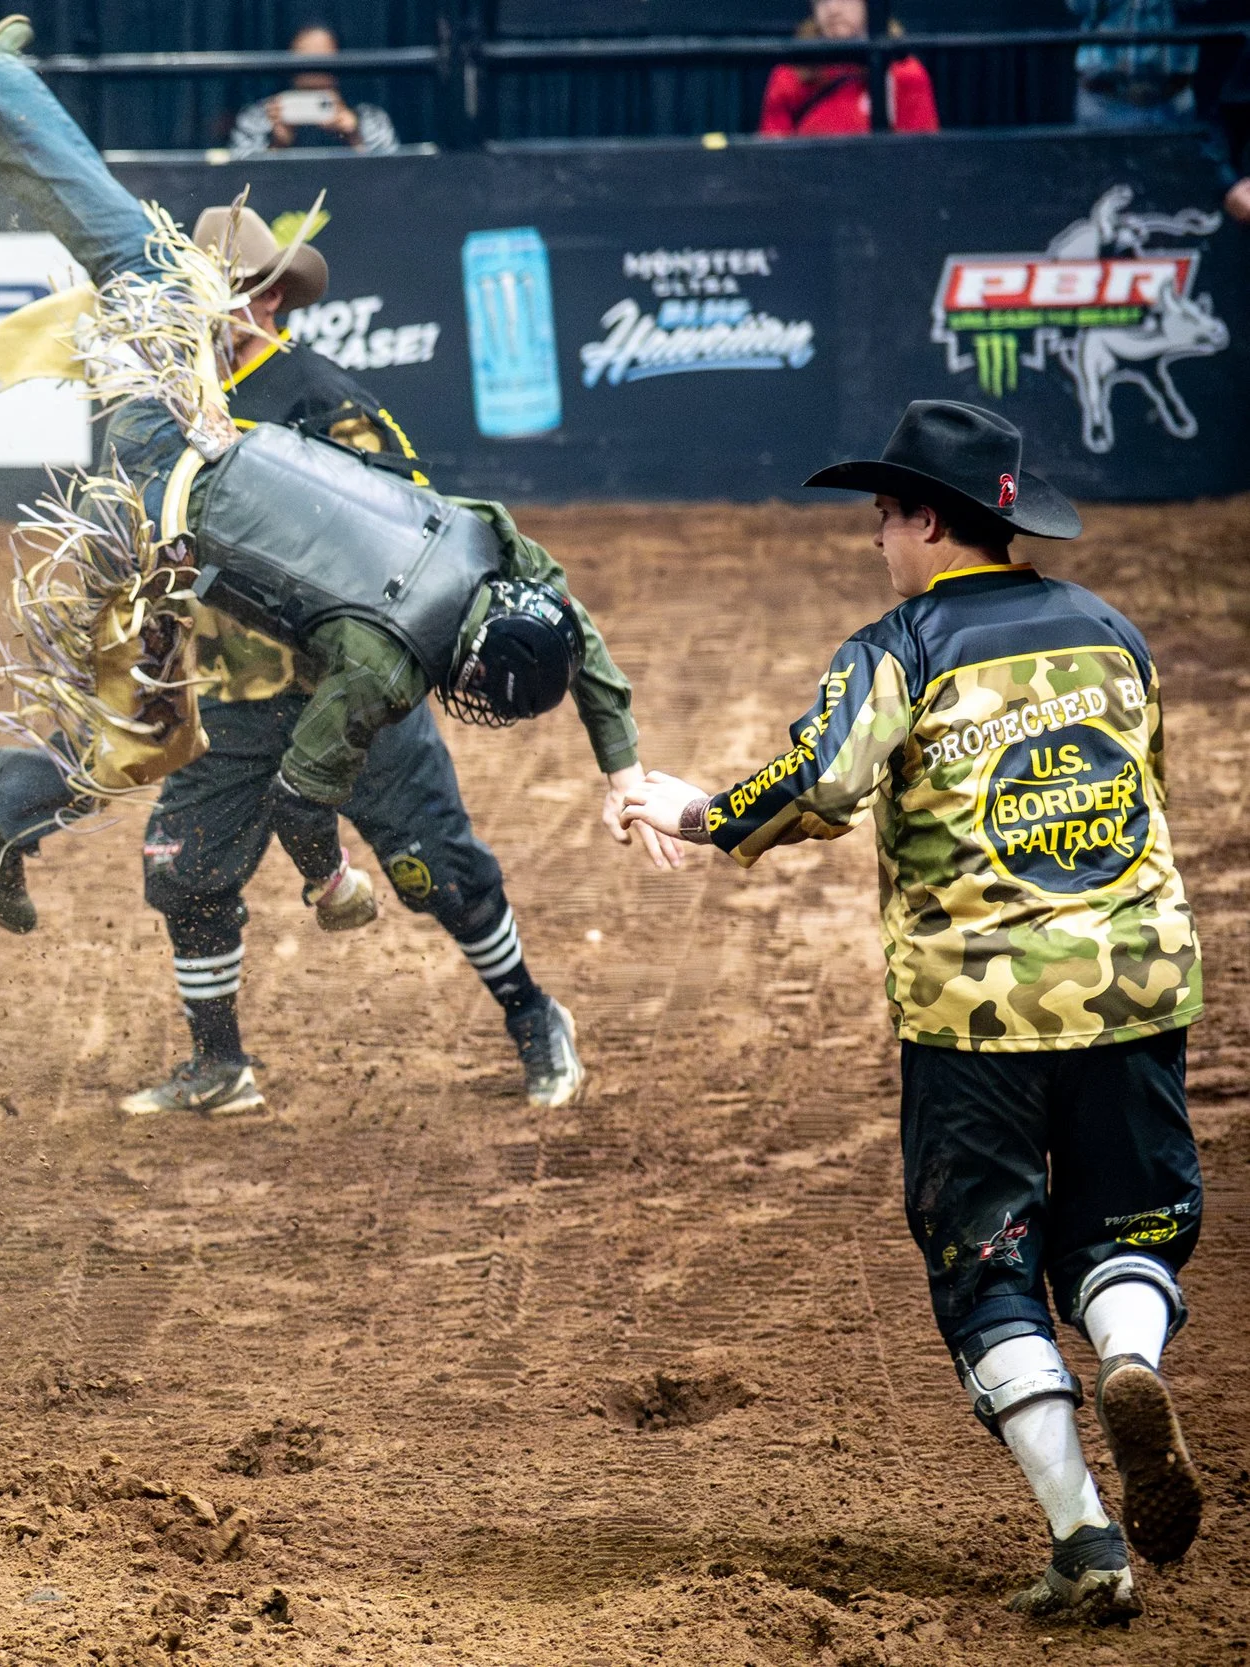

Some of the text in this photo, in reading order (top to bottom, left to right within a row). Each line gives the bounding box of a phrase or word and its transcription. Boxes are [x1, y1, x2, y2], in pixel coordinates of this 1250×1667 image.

[954, 263, 1175, 304] PBR
[923, 676, 1147, 771] PROTECTED B
[730, 744, 815, 818] BORDER
[1030, 744, 1092, 778] U.S.
[997, 779, 1134, 824] BORDER
[1002, 815, 1135, 855] PATROL
